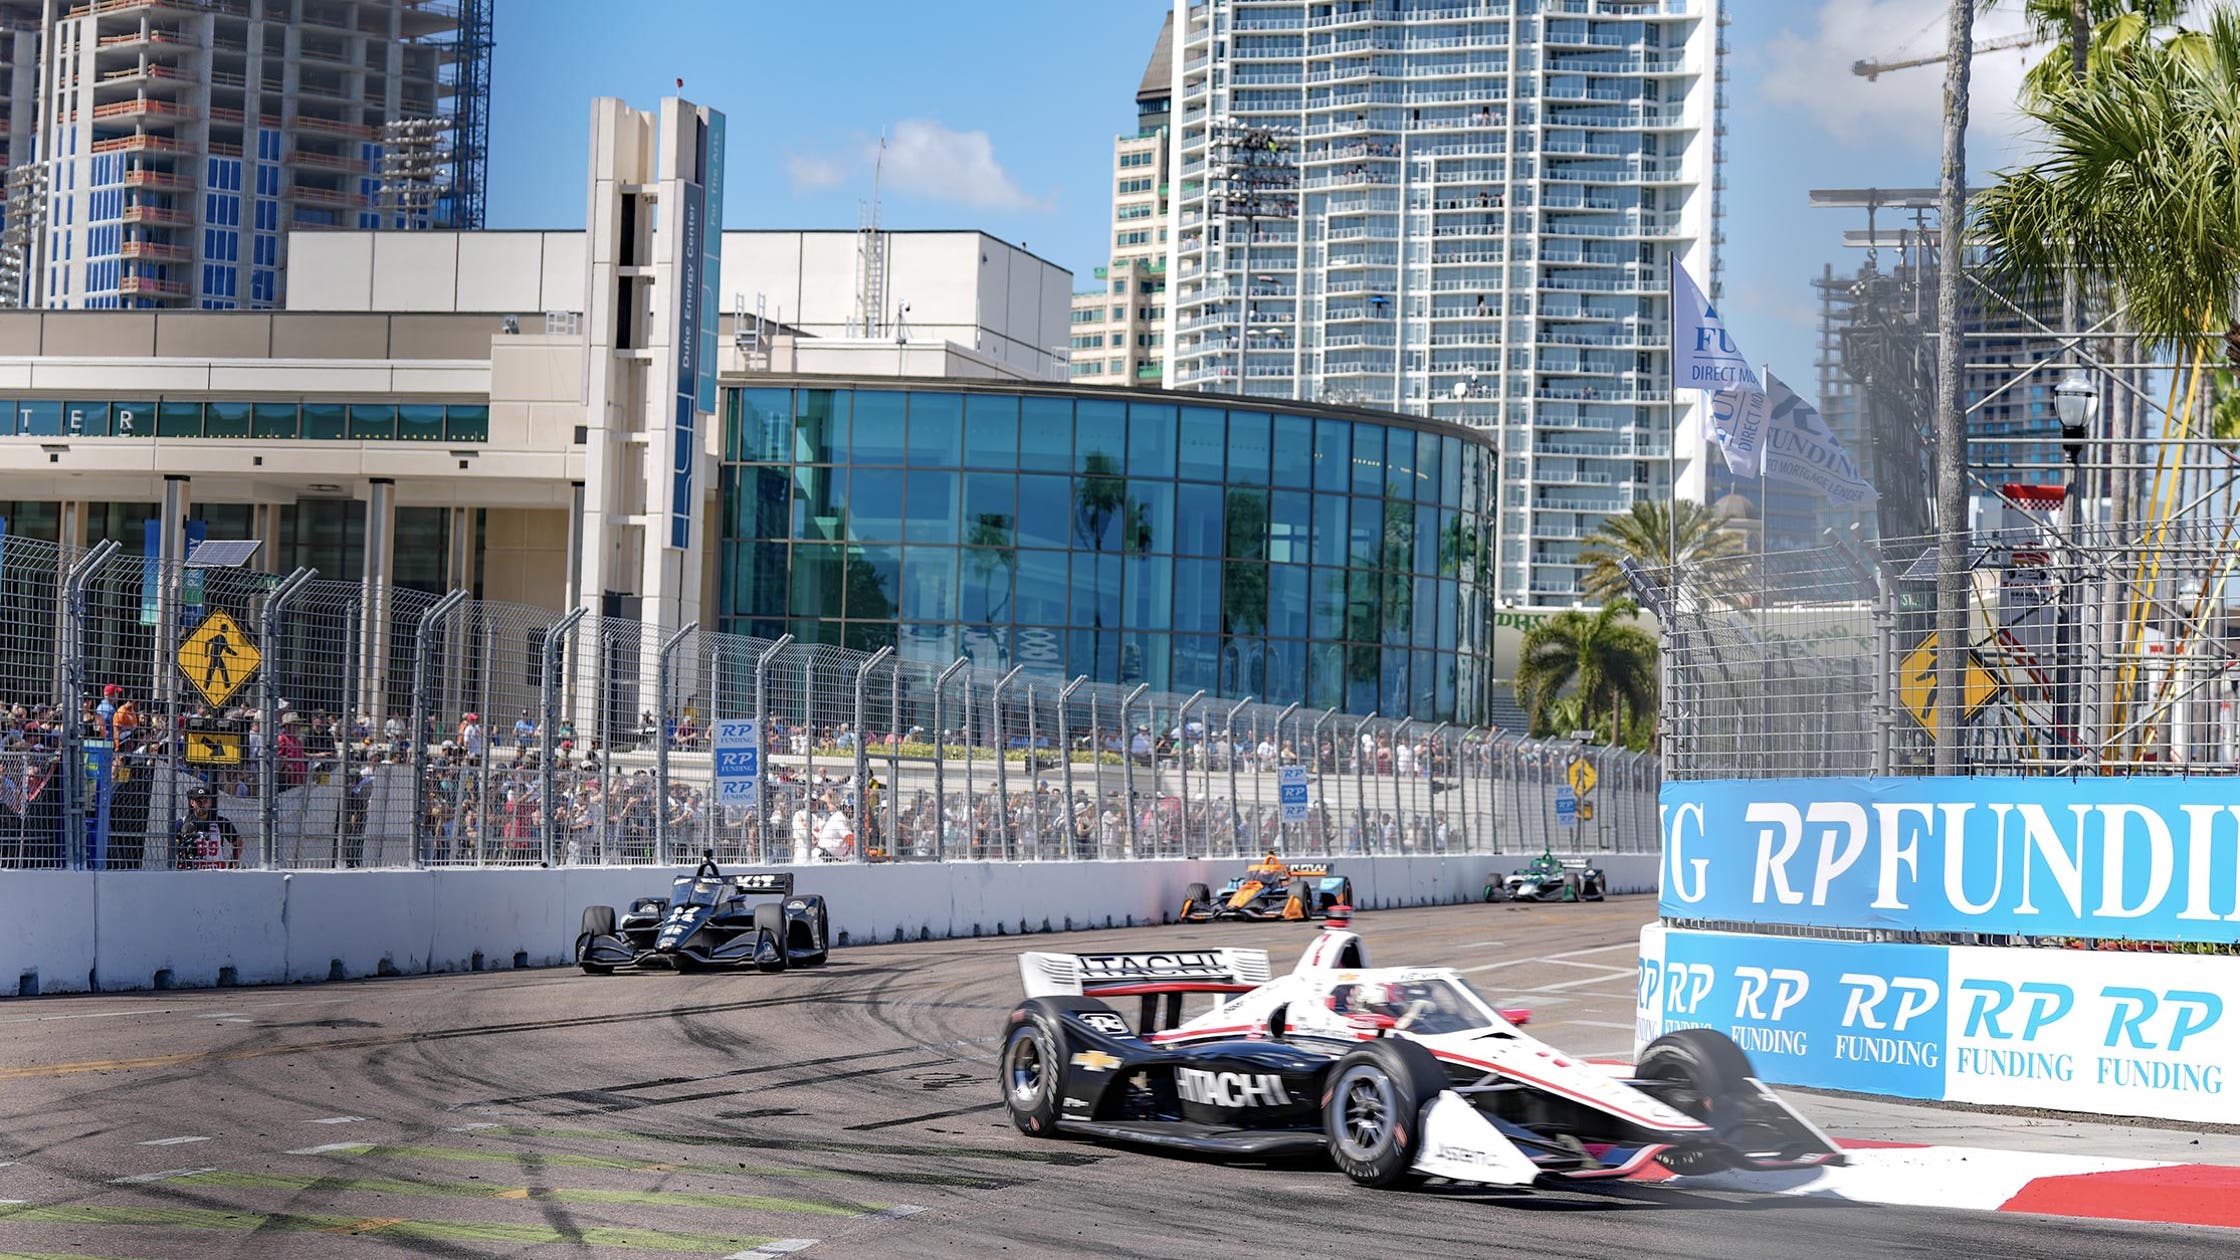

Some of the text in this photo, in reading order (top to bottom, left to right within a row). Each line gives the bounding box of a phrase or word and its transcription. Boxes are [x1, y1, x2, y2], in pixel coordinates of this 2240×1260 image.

[682, 203, 697, 369] Duke Energy Center
[1692, 365, 1736, 381] DIRECT
[1738, 410, 1762, 451] DIRECT
[721, 724, 753, 737] RP
[721, 765, 754, 773] FUNDING
[722, 752, 754, 766] RP
[1284, 769, 1304, 778] RP
[723, 781, 754, 794] RP
[1285, 787, 1305, 797] RP
[1286, 806, 1305, 815] RP
[1870, 802, 2240, 921] FUNDI
[1667, 962, 1715, 1014] RP
[1734, 966, 1810, 1021] RP
[1839, 973, 1941, 1032] RP
[1960, 978, 2074, 1041] RP
[2100, 986, 2223, 1051] RP
[1731, 1025, 1808, 1056] FUNDING
[1834, 1034, 1939, 1068] FUNDING
[1956, 1047, 2074, 1082] FUNDING
[2096, 1056, 2223, 1094] FUNDING
[1176, 1066, 1293, 1107] HITACHI
